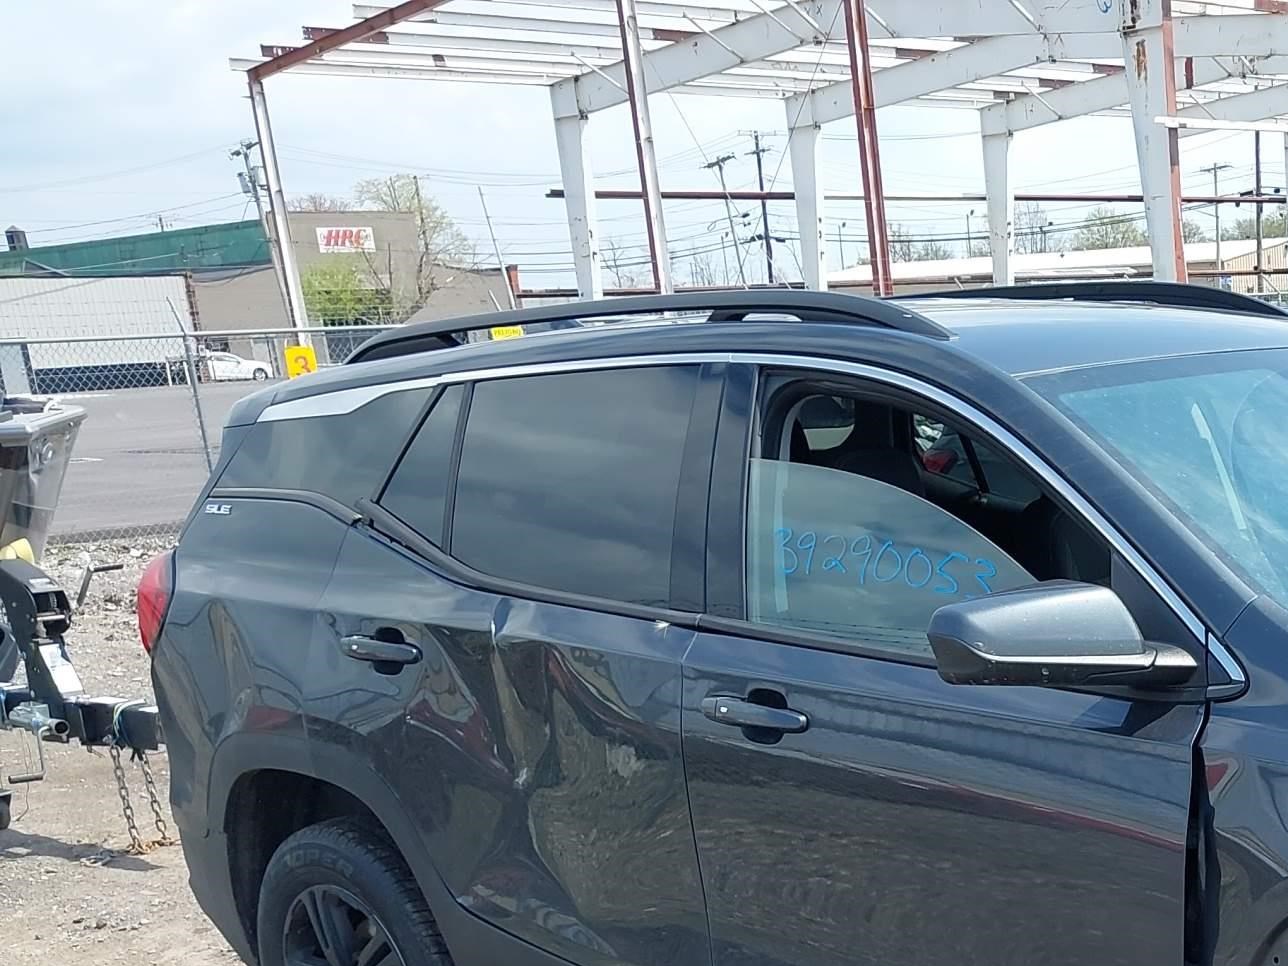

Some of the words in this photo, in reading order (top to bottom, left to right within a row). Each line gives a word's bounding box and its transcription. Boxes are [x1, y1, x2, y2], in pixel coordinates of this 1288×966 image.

[325, 229, 366, 247] HRC
[205, 504, 232, 514] SLE
[774, 528, 997, 598] 39290053
